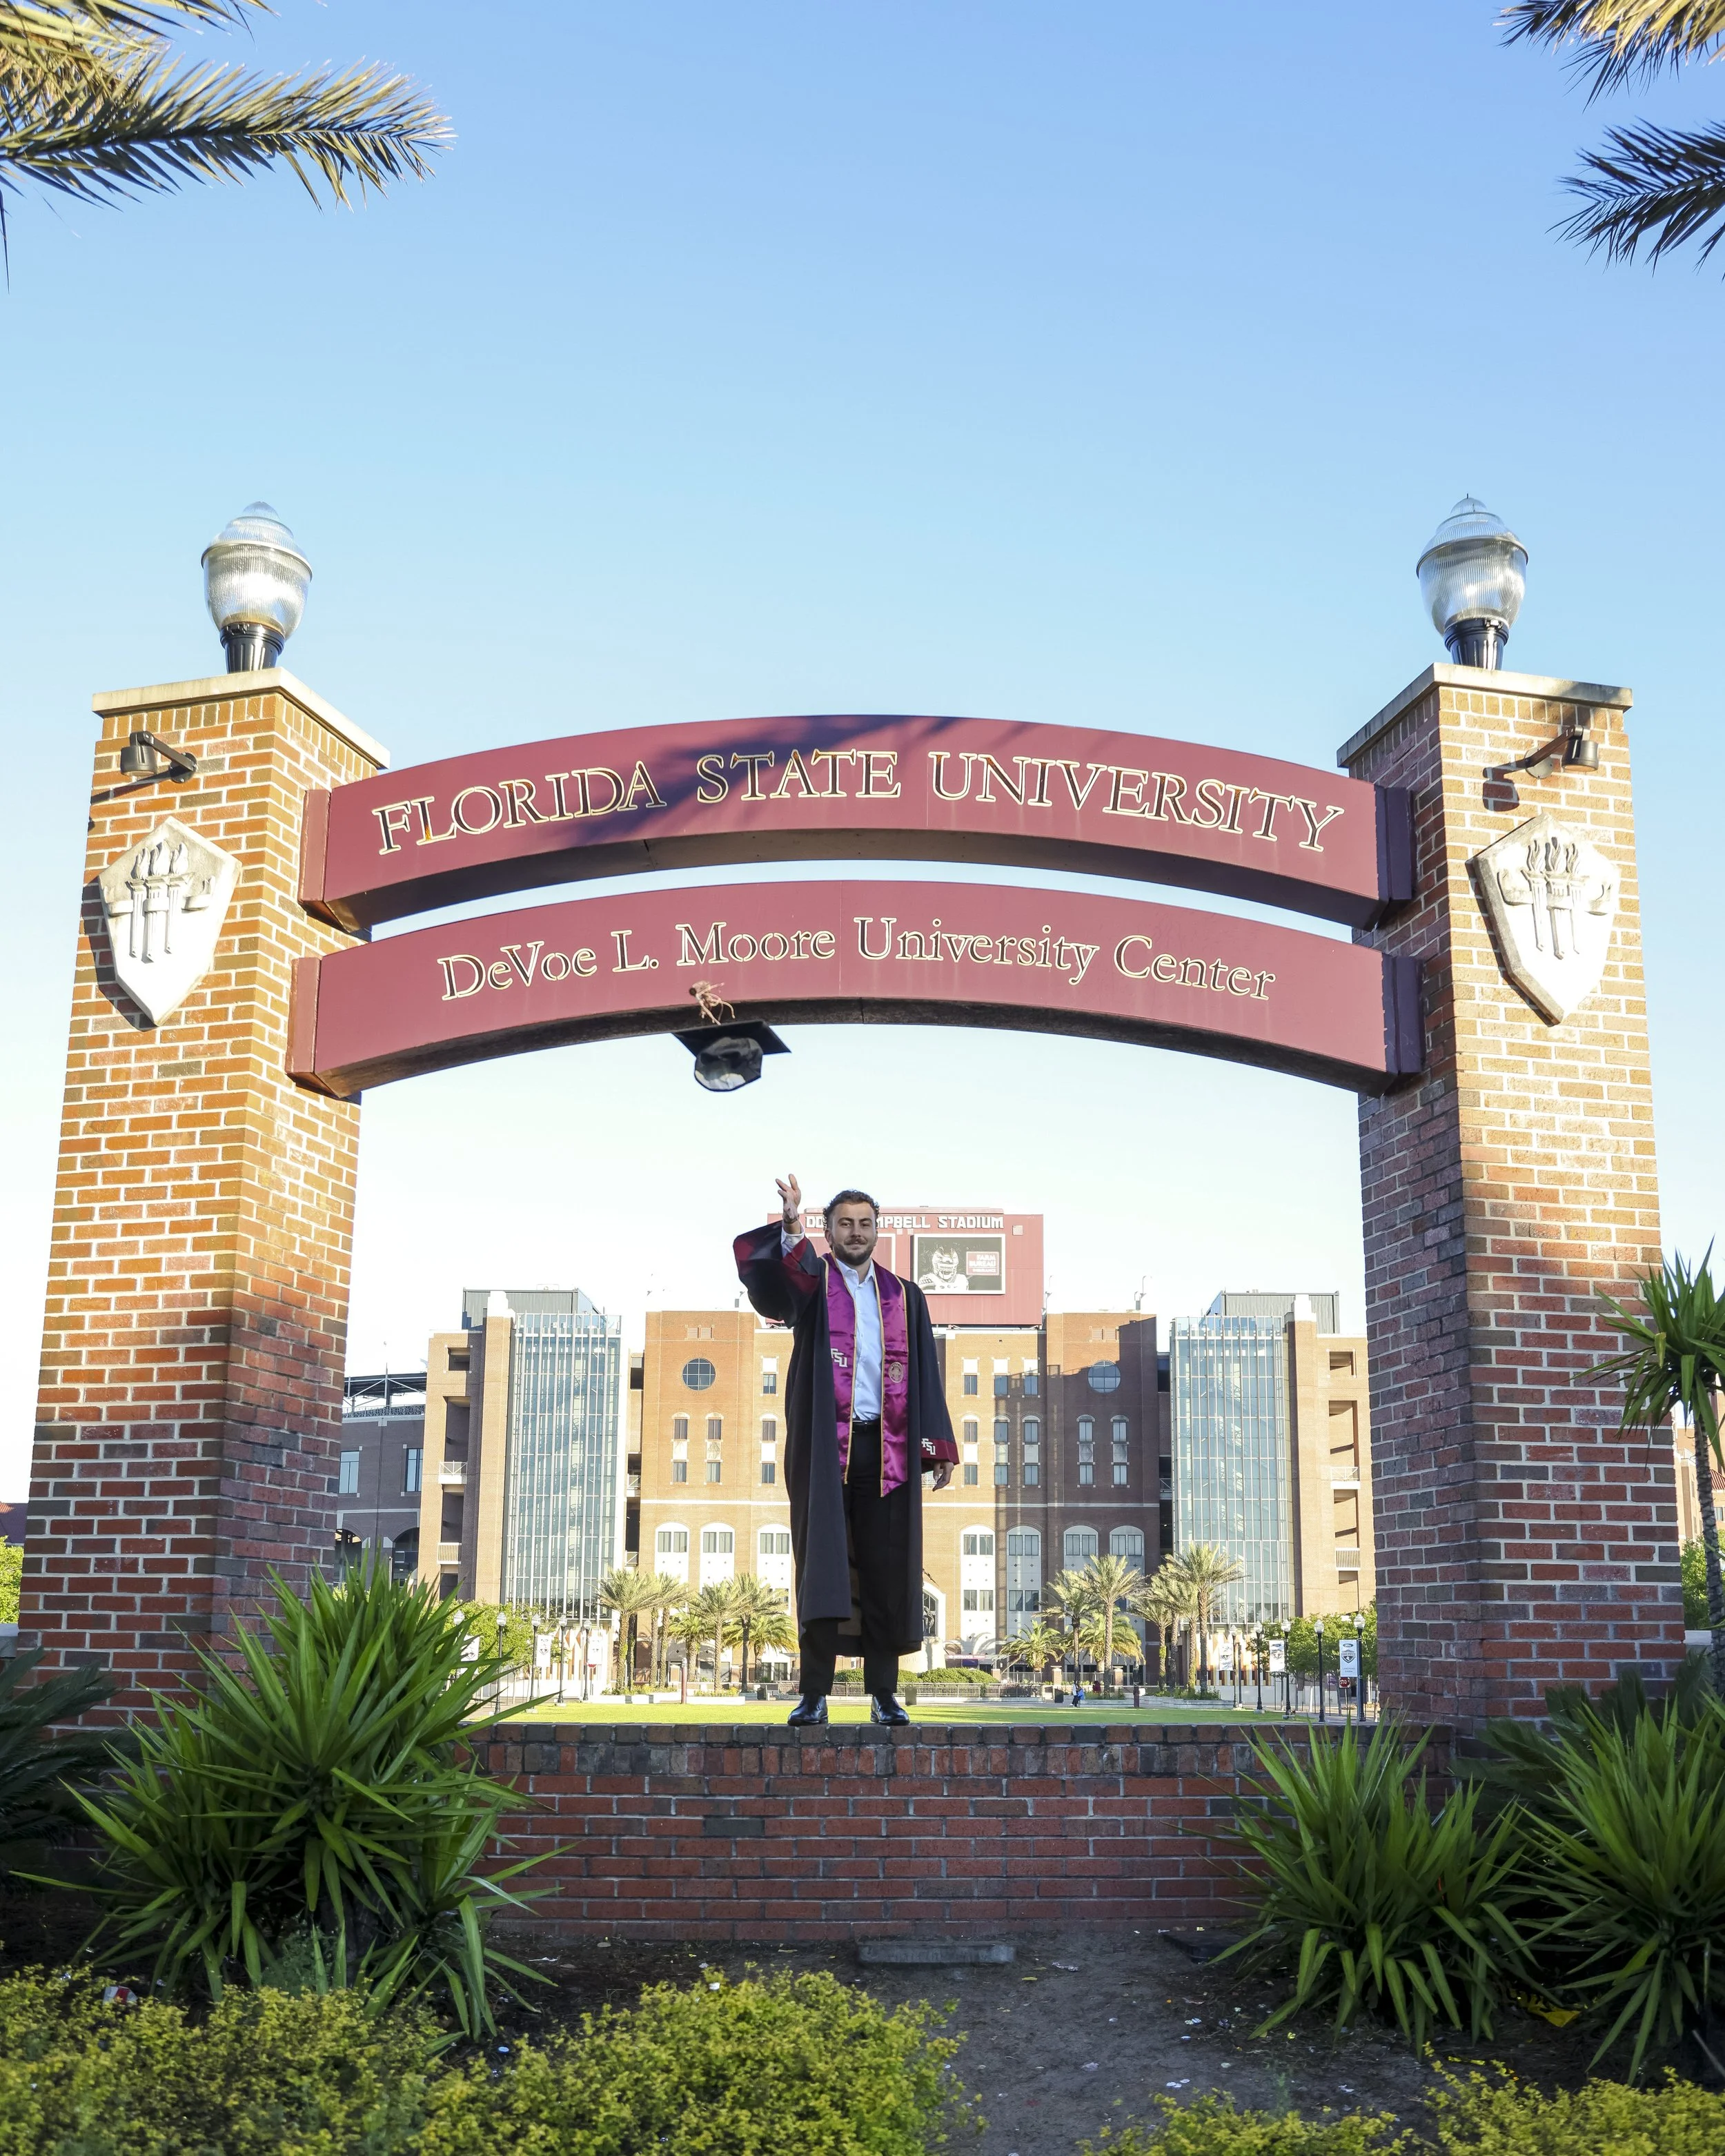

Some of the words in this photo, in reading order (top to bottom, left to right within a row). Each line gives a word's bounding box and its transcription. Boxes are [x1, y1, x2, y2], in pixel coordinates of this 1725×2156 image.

[372, 760, 667, 856] FLORIDA
[696, 749, 902, 803] STATE
[927, 751, 1344, 853] UNIVERSITY
[436, 940, 598, 1001] DeVoe
[611, 929, 660, 973] L.
[675, 921, 836, 966] Moore
[853, 916, 1101, 986] University
[1113, 934, 1276, 1001] Center
[876, 1216, 930, 1229] MPBELL
[937, 1216, 1004, 1229] STADIUM
[830, 1347, 848, 1368] FSU
[921, 1438, 936, 1456] FSU
